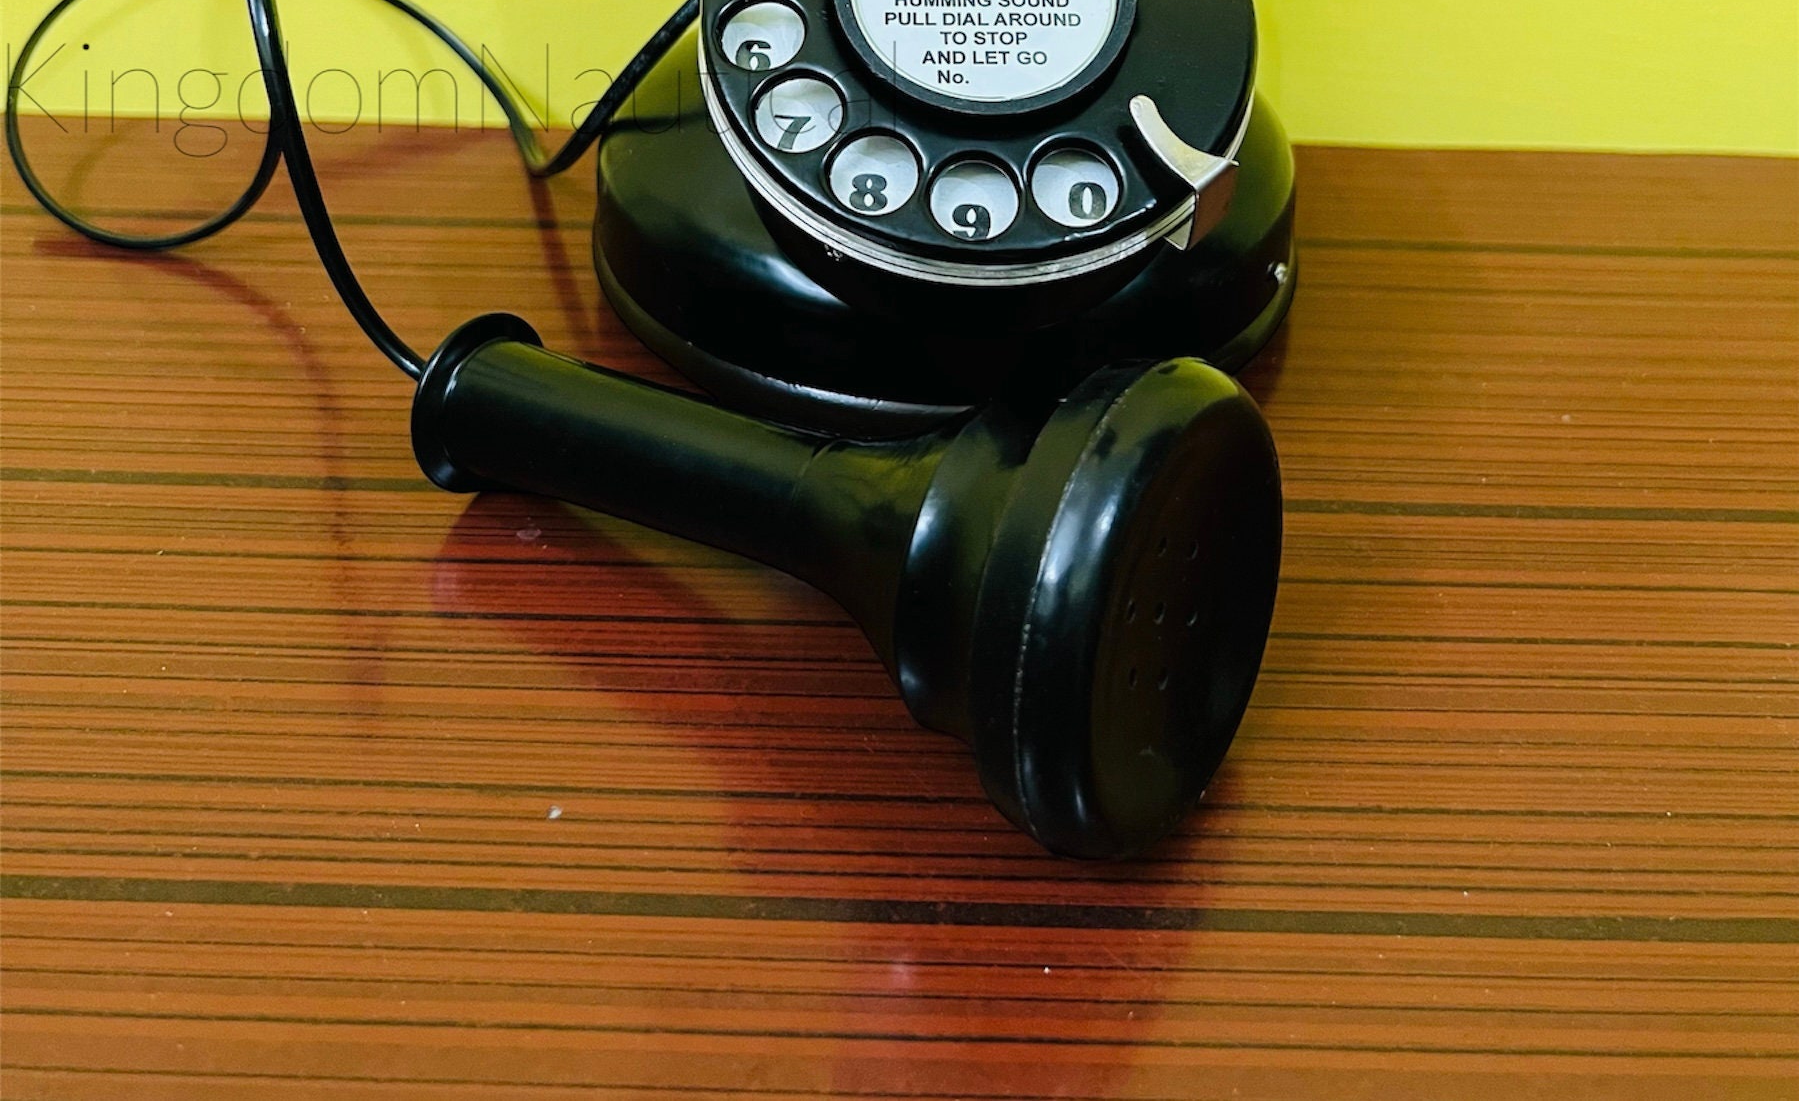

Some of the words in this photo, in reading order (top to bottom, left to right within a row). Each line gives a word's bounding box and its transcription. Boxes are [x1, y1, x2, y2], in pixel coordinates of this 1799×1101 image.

[884, 12, 937, 26] PULL
[943, 12, 990, 26] DIAL
[994, 13, 1082, 27] AROUND
[940, 31, 967, 45] TO
[973, 31, 1028, 45] STOP
[735, 40, 771, 71] 6
[922, 50, 966, 65] AND
[973, 51, 1010, 65] LET
[1017, 51, 1048, 65] GO
[937, 69, 970, 84] No.
[774, 114, 812, 150] 7
[849, 173, 888, 212] 8
[1067, 181, 1107, 220] 0
[952, 203, 992, 240] 9
